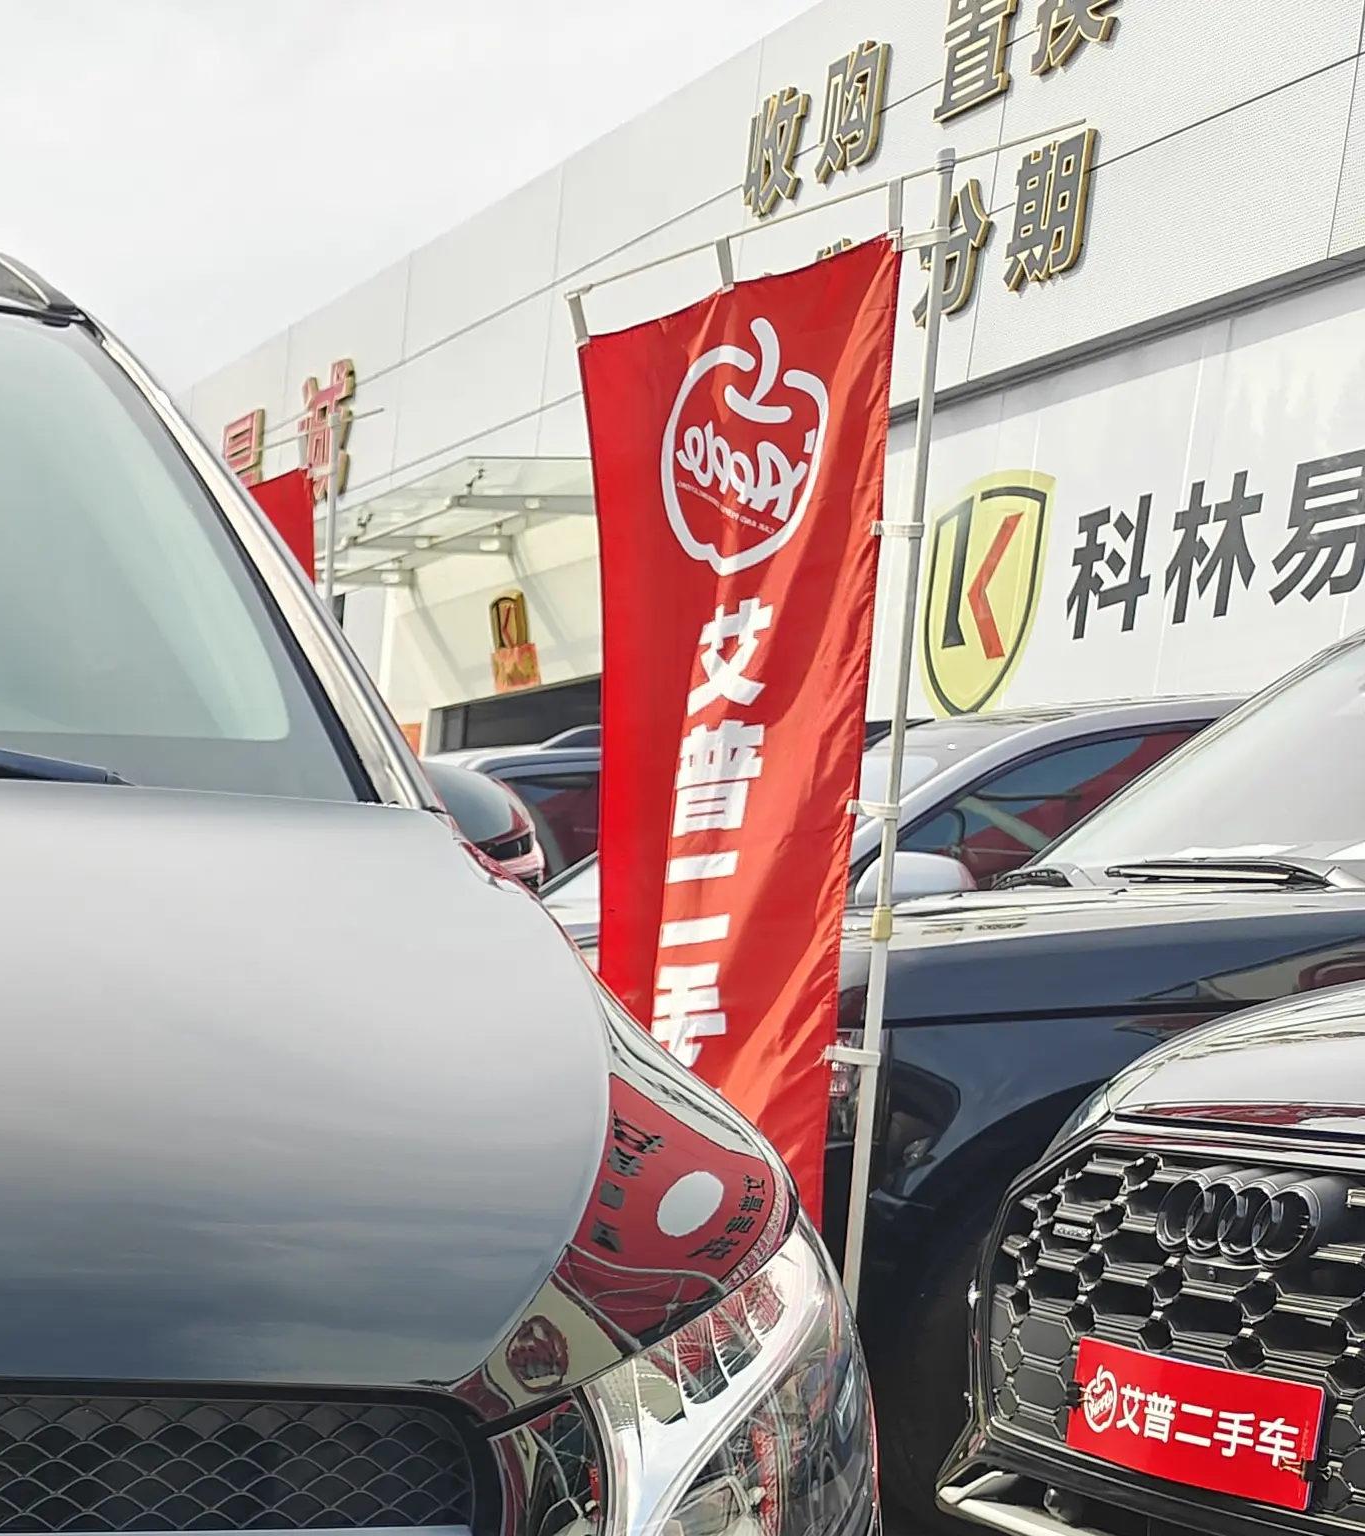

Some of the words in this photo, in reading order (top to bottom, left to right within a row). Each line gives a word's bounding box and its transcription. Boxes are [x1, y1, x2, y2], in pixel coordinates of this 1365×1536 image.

[743, 40, 892, 217] 收购
[912, 128, 1098, 327] 分期
[1116, 1383, 1300, 1467] 艾普二手车
